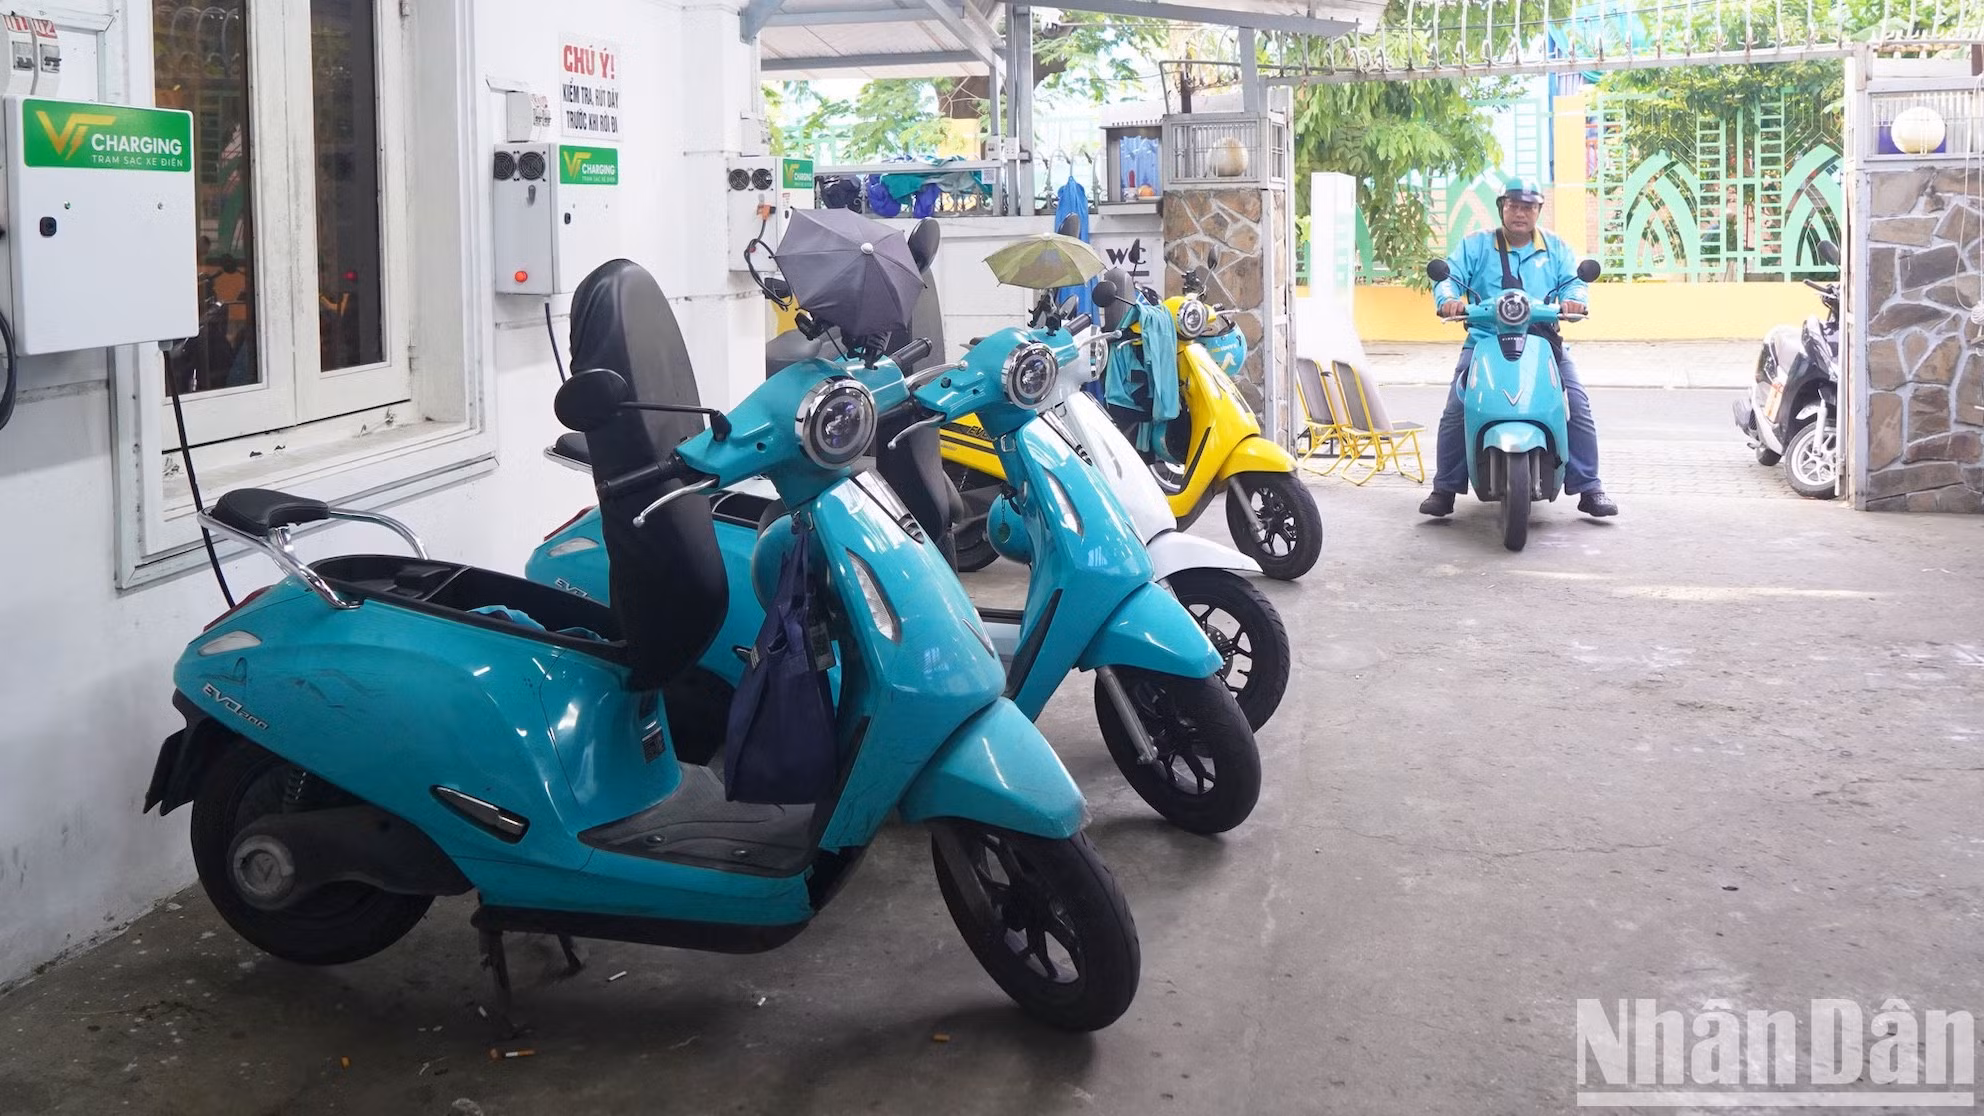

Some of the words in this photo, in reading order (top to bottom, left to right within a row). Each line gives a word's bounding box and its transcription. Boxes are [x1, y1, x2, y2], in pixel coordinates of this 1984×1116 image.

[563, 44, 595, 76] CHÚ
[599, 47, 615, 80] Ý!
[562, 77, 580, 103] KIỂM
[595, 85, 606, 107] RÚT
[566, 108, 587, 131] TRƯỚC
[588, 113, 599, 132] KHI
[91, 133, 182, 156] CHARGING
[145, 157, 158, 167] XE
[581, 163, 616, 176] CHARGING
[1105, 247, 1147, 265] WC
